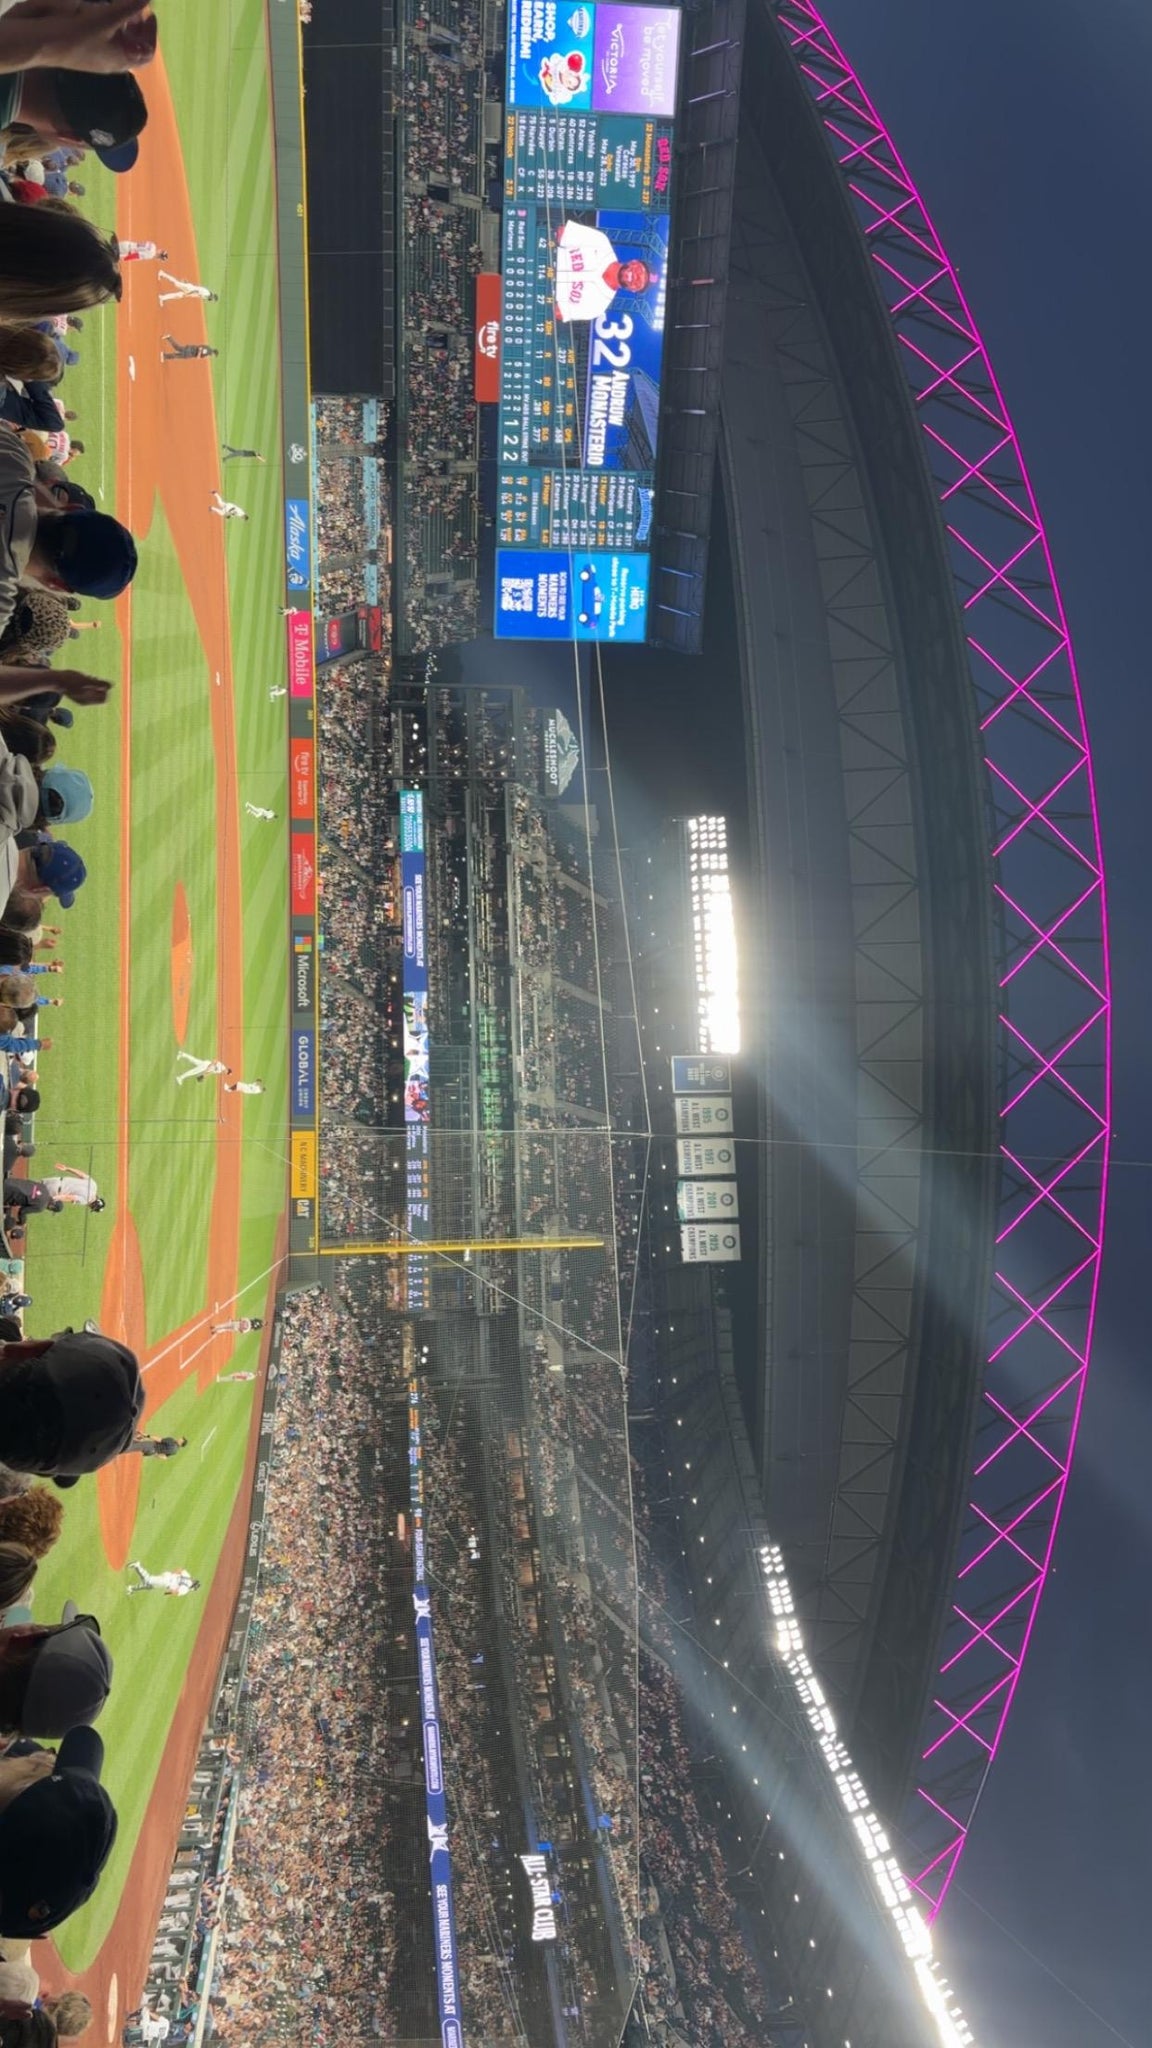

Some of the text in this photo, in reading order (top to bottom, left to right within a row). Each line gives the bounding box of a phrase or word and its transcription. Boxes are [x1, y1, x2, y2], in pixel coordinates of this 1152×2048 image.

[520, 0, 532, 59] REDEEM!
[532, 1, 545, 43] EARN,
[543, 2, 557, 43] SHOP,
[607, 28, 620, 91] VICTORIA
[640, 26, 654, 95] be moved
[506, 126, 515, 158] Whitlock
[518, 125, 526, 147] Eaton
[537, 126, 546, 150] Mayer
[558, 128, 566, 151] Duran
[567, 128, 575, 164] Contreras
[577, 129, 585, 151] Abreu
[587, 129, 596, 158] Yoshida
[600, 138, 608, 154] May
[614, 145, 623, 182] Venezuela
[622, 149, 630, 179] Caracas
[644, 133, 653, 173] Monasterio
[654, 137, 670, 191] RED SOX
[506, 220, 515, 251] Mariners
[518, 221, 526, 235] Red
[486, 321, 500, 358] fire tv
[532, 237, 546, 443] 42 114 27 12 11 .281 .377
[557, 346, 567, 364] .237
[593, 313, 634, 426] 32 ANDRUW
[587, 374, 612, 466] MONASTERIO
[502, 434, 519, 445] 2
[502, 451, 519, 463] 2
[553, 483, 561, 511] Emerson
[571, 483, 579, 501] Raley
[579, 485, 587, 503] Young
[615, 485, 625, 509] Raleigh
[289, 505, 306, 561] Alaska
[559, 572, 567, 586] SCAN
[536, 573, 548, 618] MOMENTS
[547, 573, 558, 618] MARINERS
[609, 587, 618, 619] T-Mobile
[629, 586, 641, 610] HERO
[616, 598, 626, 625] parking
[608, 620, 616, 637] Park
[294, 624, 310, 685] T Mobile
[548, 719, 558, 786] MUCKLESHOOT
[415, 901, 423, 929] MARINERS
[416, 931, 424, 958] MOMENTS
[297, 955, 310, 1007] Microsoft
[298, 1036, 308, 1086] GLOBAL
[681, 1100, 690, 1131] CHAMPIONS
[683, 1141, 692, 1174] CHAMPIONS
[694, 1155, 702, 1170] WEST
[300, 1154, 309, 1192] MACHINERY
[297, 1200, 310, 1218] CAT
[685, 1184, 695, 1217] CHAMPIONS
[697, 1198, 705, 1213] WEST
[707, 1192, 717, 1209] 2001
[687, 1227, 697, 1260] CHAMPIONS
[699, 1241, 707, 1256] WEST
[261, 1412, 275, 1436] STIHL
[249, 1530, 259, 1557] LEXUS
[420, 1647, 431, 1659] YOUR
[421, 1660, 433, 1686] MARINERS
[423, 1687, 435, 1713] MOMENTS
[436, 1885, 448, 1898] SEE
[437, 1899, 450, 1918] YOUR
[531, 1908, 557, 1941] CLUB
[438, 1919, 453, 1960] MARINERS
[441, 1961, 455, 2003] MOMENTS
[444, 2005, 456, 2016] AT
